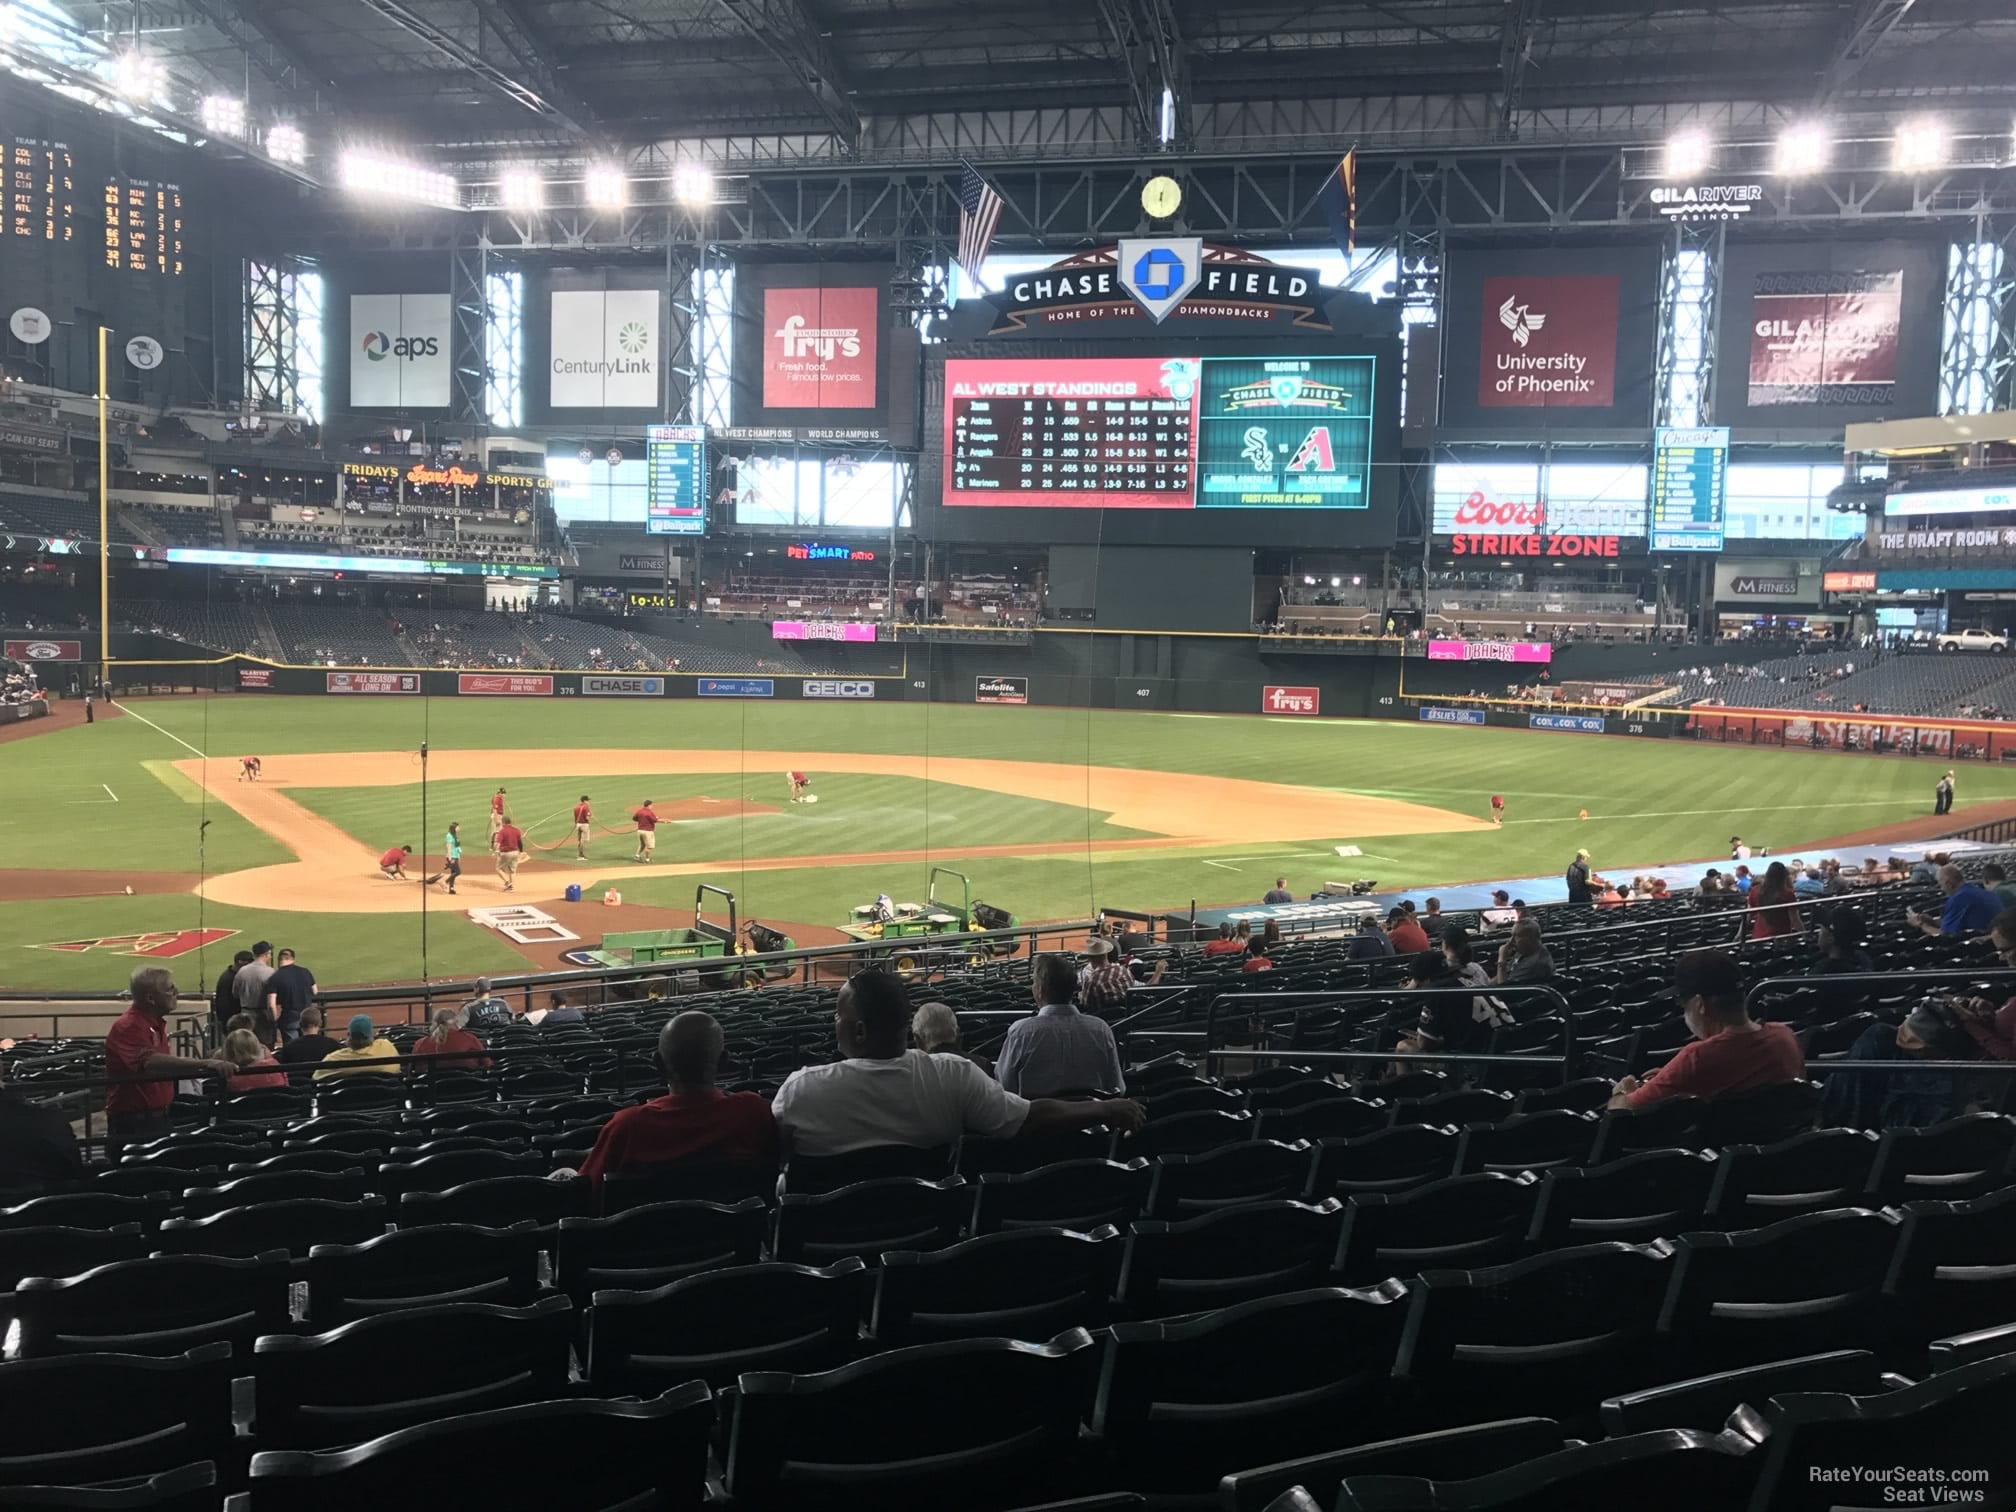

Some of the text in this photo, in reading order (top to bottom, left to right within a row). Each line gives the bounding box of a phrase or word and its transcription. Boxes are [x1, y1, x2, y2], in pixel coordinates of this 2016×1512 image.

[15, 137, 36, 145] TEAM
[16, 148, 31, 157] COL
[16, 157, 30, 166] PHI
[130, 178, 149, 187] TEAM
[16, 194, 32, 203] PIT
[16, 204, 32, 212] ATL
[1670, 213, 1739, 222] CASINOS
[16, 227, 32, 235] CHC
[1014, 272, 1308, 302] CHASE FIELD
[1048, 306, 1270, 321] HOME OF THE DIAMONDBACKS
[774, 315, 861, 361] fry's
[394, 337, 438, 361] aps
[553, 358, 650, 376] CenturyLink
[780, 362, 828, 371] Fresh food.
[1497, 353, 1586, 374] University
[787, 373, 863, 383] Famous low prices.
[953, 382, 1137, 395] AL WEST STANDINGS
[1496, 375, 1515, 392] of
[1233, 389, 1339, 400] CHASE FIELD
[970, 417, 992, 425] Astros
[1023, 417, 1033, 425] 29
[1157, 417, 1168, 425] L3
[1175, 417, 1189, 425] 6-4
[714, 430, 792, 438] NL WEST CHAMPIONS
[808, 430, 879, 438] WORLD CHAMPIONS
[970, 433, 998, 442] Rangers
[1022, 433, 1032, 441] 24
[1043, 433, 1053, 441] 21
[1156, 433, 1168, 441] W1
[1175, 433, 1188, 441] 9-1
[1663, 430, 1718, 446] Chicago
[38, 438, 59, 449] SEATS
[970, 448, 993, 457] Angels
[1022, 448, 1032, 457] 23
[1043, 448, 1053, 457] 23
[1084, 448, 1098, 457] 7.0
[1155, 448, 1167, 457] W1
[969, 464, 980, 472] A's
[1022, 464, 1032, 472] 20
[1042, 464, 1053, 472] 24
[1084, 464, 1097, 472] 9.0
[1104, 464, 1122, 472] 14-9
[1156, 464, 1166, 472] L1
[344, 464, 399, 478] FRIDAY'S
[486, 474, 533, 487] SPORTS
[969, 479, 999, 488] Mariners
[1021, 480, 1032, 488] 20
[1042, 480, 1052, 488] 25
[1155, 480, 1166, 488] L3
[1173, 480, 1186, 488] 3-7
[1455, 491, 1546, 525] Coors
[1671, 535, 1719, 549] Ballpark
[1879, 530, 1999, 549] THE DRAFT ROOM
[1452, 534, 1619, 556] STRIKE ZONE
[788, 546, 874, 560] PETSMART PATIO
[621, 557, 664, 569] M FITNESS
[1737, 578, 1796, 594] M FITNESS
[369, 675, 397, 683] SEASON
[361, 683, 380, 691] LONG
[590, 680, 641, 692] CHASE
[806, 682, 873, 695] GEICO
[913, 681, 926, 689] 413
[1606, 689, 1626, 697] TRUCKS
[1269, 688, 1313, 711] fry's
[1379, 697, 1393, 705] 413
[1428, 710, 1456, 720] LESLIE'S
[1629, 725, 1643, 733] 376
